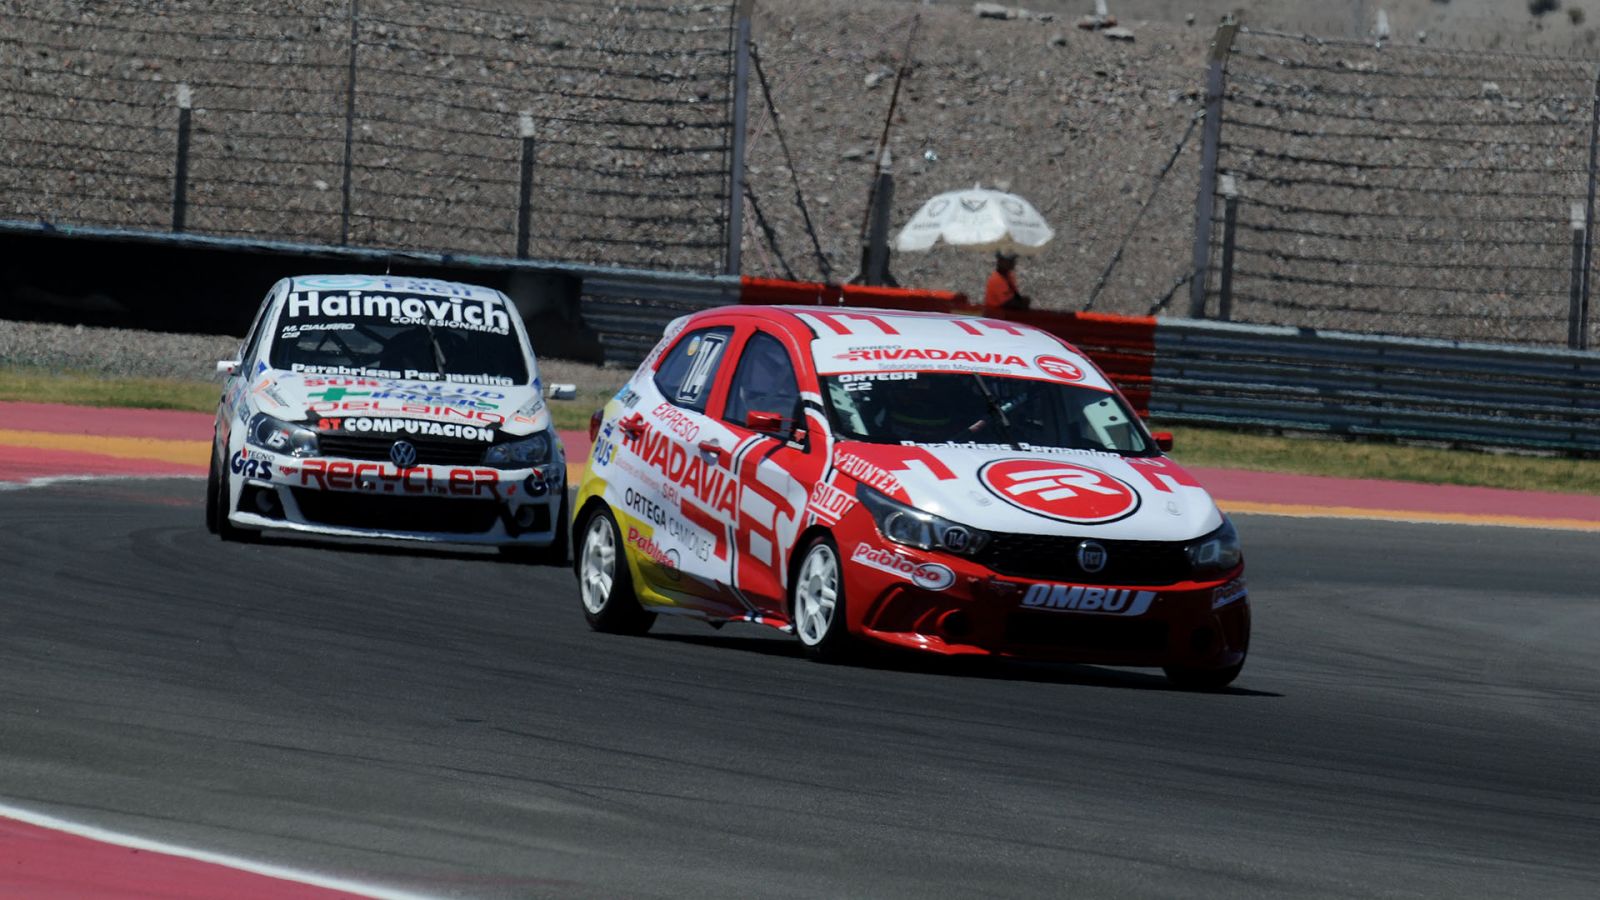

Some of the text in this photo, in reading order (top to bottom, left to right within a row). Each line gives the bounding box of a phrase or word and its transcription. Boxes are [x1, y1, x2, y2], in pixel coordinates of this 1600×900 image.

[289, 291, 509, 330] Haimovich
[291, 362, 401, 380] Parabrisas
[847, 349, 1029, 369] RIVADAVIA
[878, 362, 935, 371] Soluciones
[838, 371, 918, 383] ORTEGA
[843, 382, 872, 392] C2
[318, 417, 341, 431] ST
[344, 417, 495, 443] COMPUTACION
[651, 402, 701, 443] EXPRESO
[231, 450, 273, 481] GAS
[247, 450, 275, 461] TECNO
[842, 454, 902, 496] HUNTER
[625, 486, 667, 528] ORTEGA
[854, 542, 941, 582] Pabloso
[1021, 583, 1131, 611] OMBU
